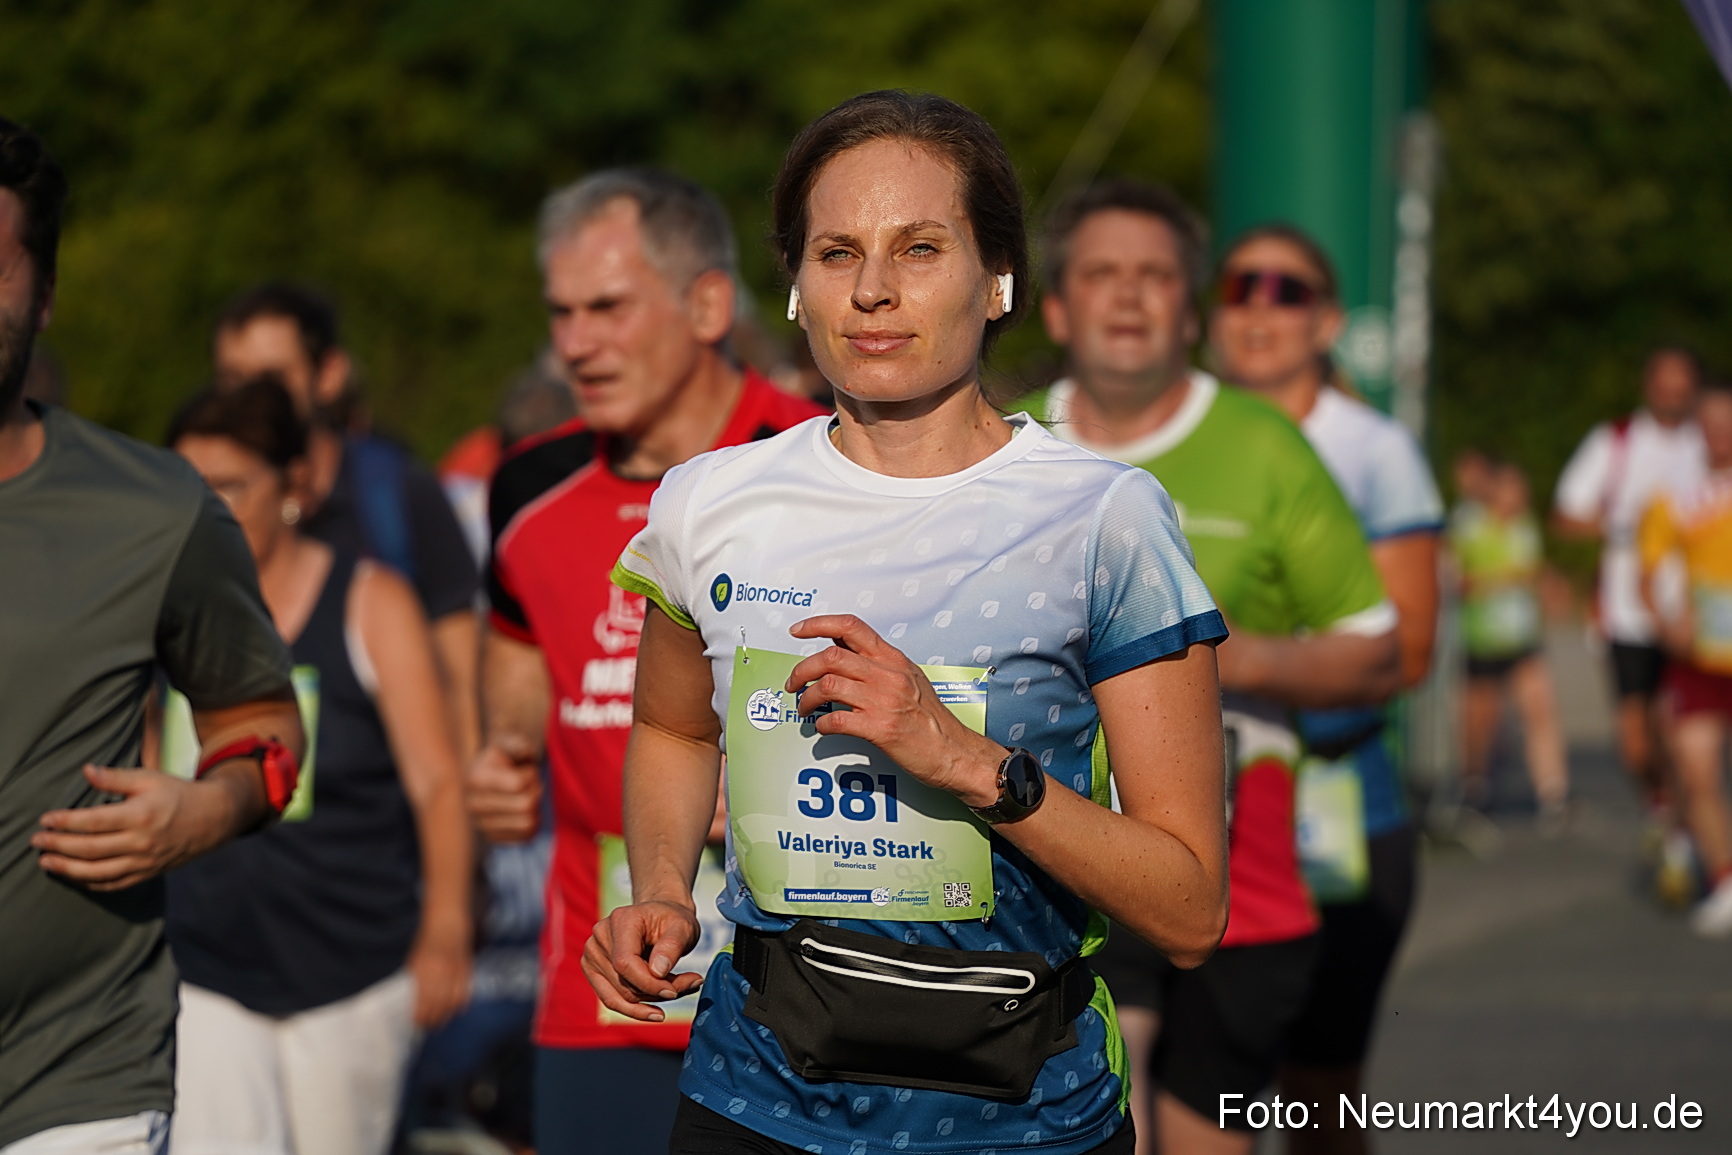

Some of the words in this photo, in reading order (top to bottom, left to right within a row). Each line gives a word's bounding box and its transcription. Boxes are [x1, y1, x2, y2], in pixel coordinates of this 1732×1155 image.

[797, 768, 899, 823] 381
[777, 830, 868, 859] Valeriya
[873, 838, 934, 860] Stark
[834, 861, 866, 869] Bionorica
[788, 891, 868, 902] firmenlauf.bayern
